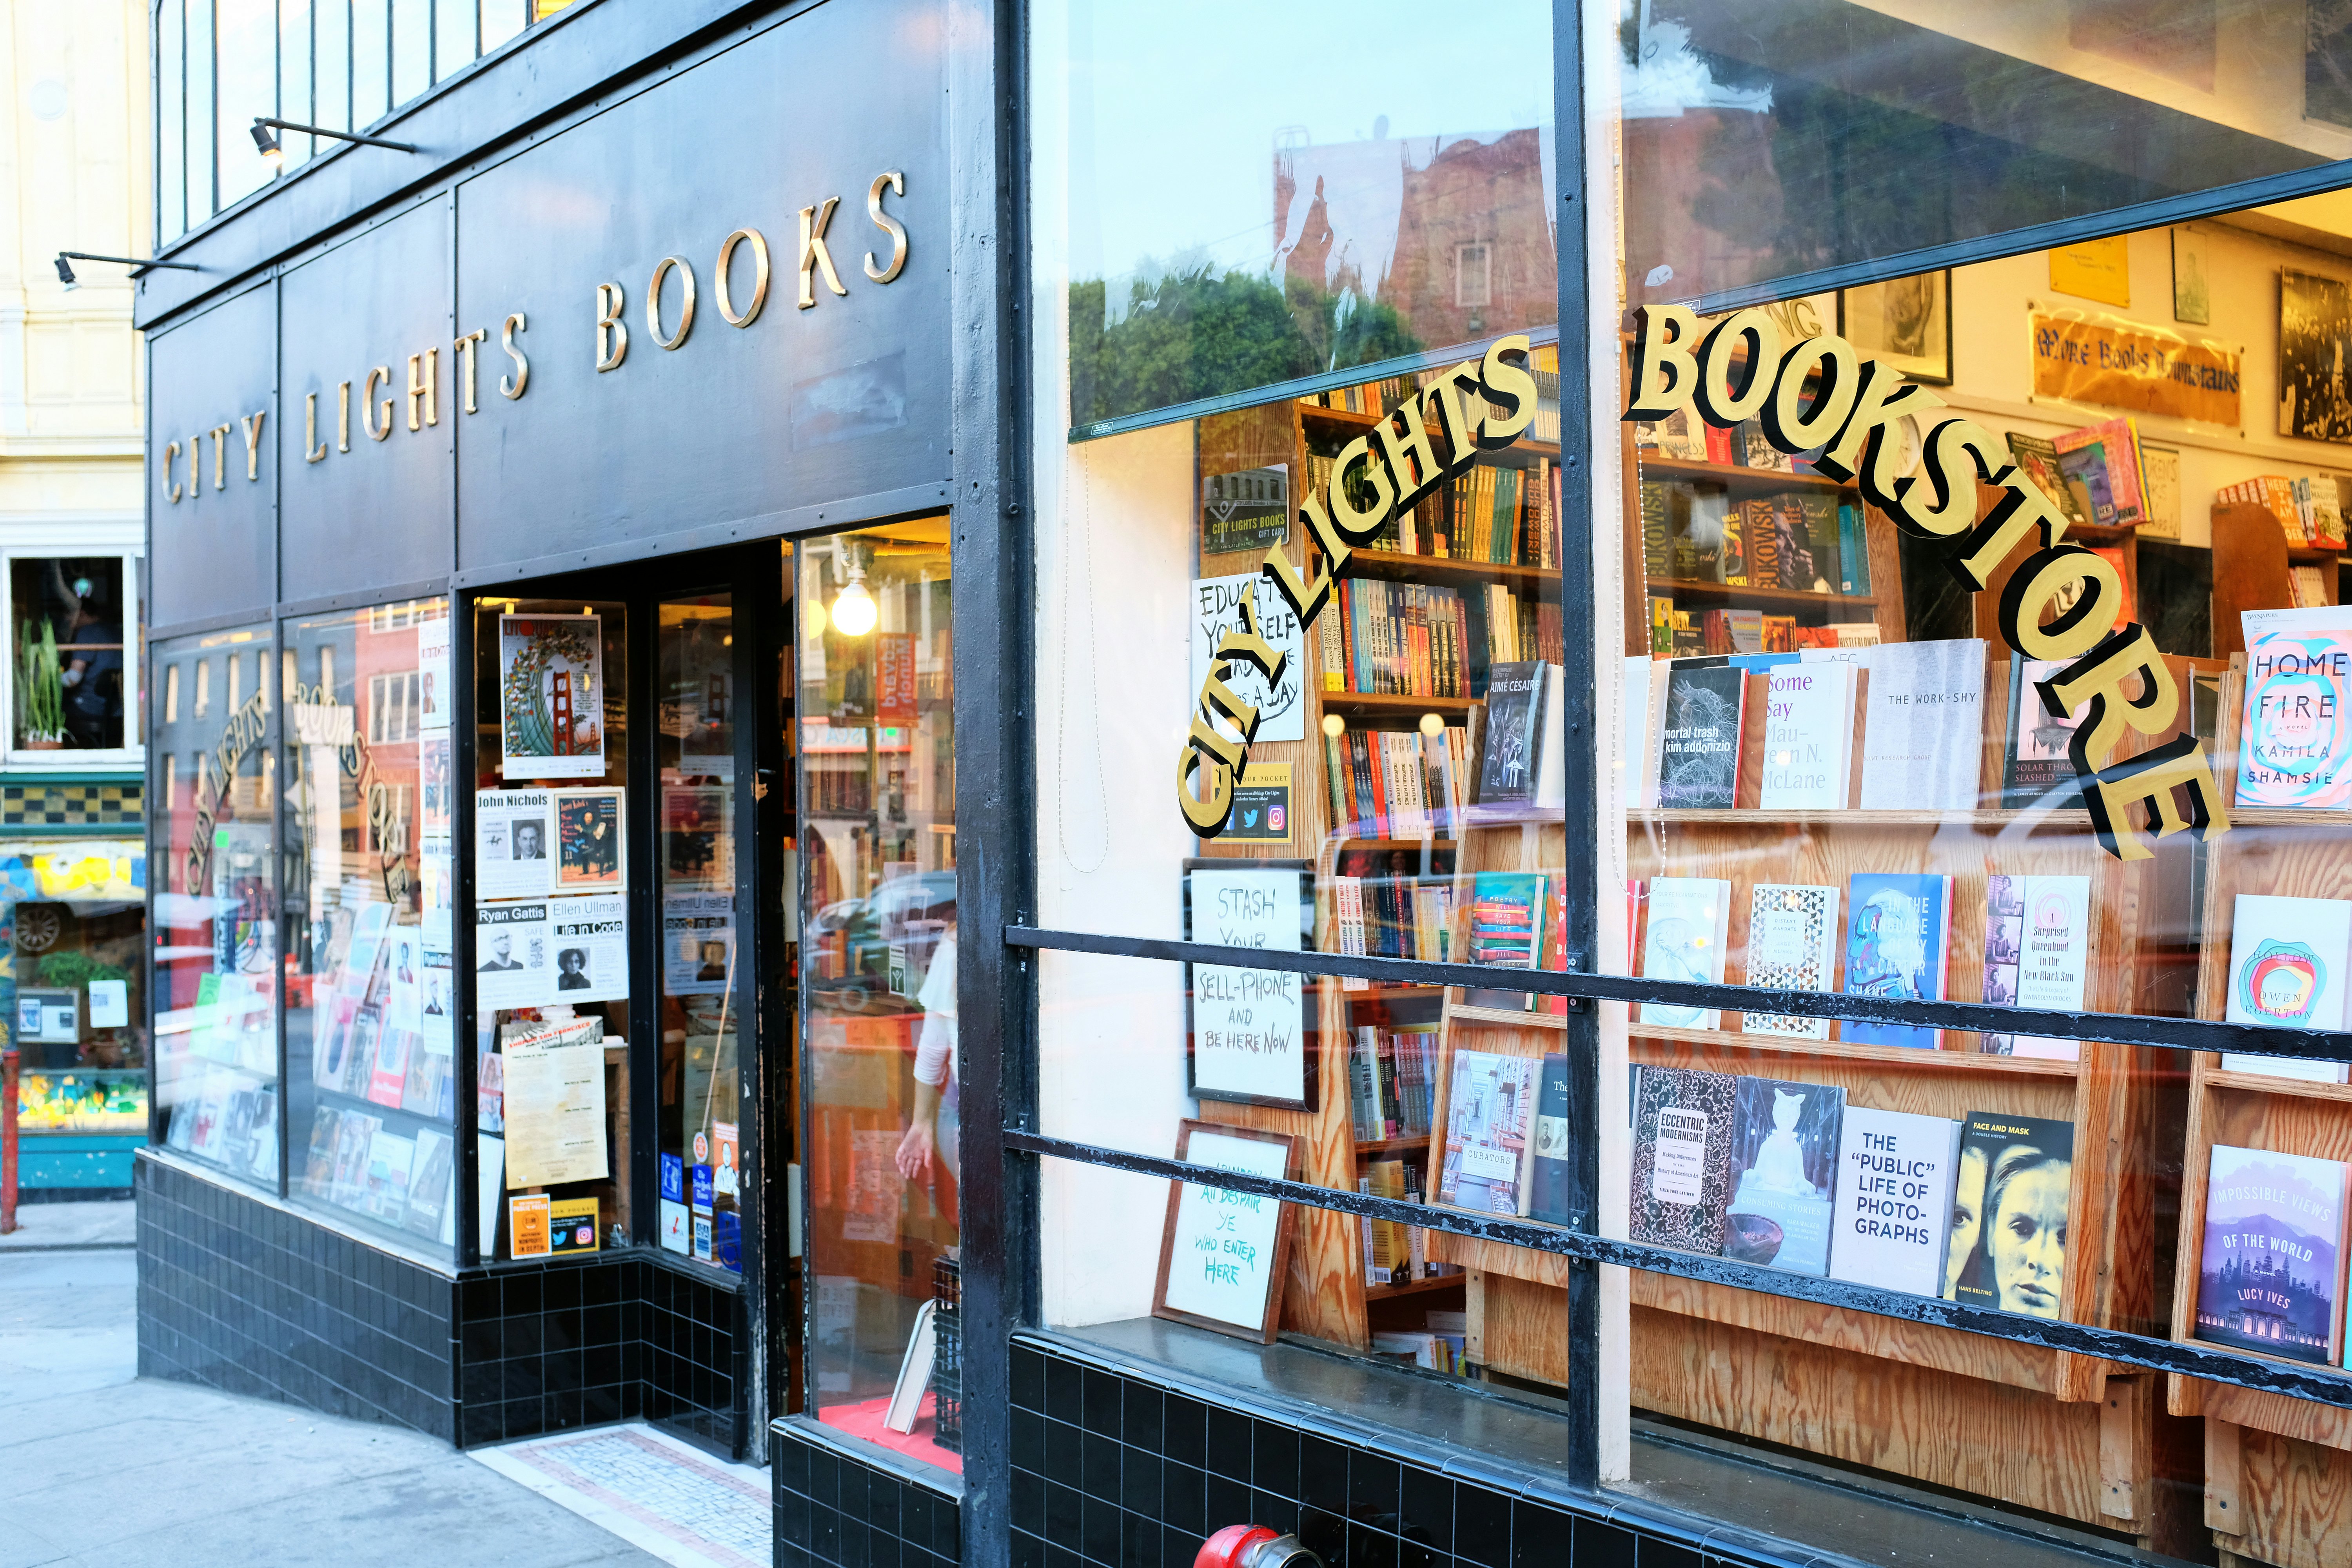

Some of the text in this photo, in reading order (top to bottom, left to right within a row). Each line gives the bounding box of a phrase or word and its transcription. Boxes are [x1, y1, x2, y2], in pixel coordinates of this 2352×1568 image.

[162, 171, 909, 504] CITY LIGHTS BOOKS
[2098, 339, 2149, 376] Books
[2153, 346, 2239, 393] Downstairs
[2266, 478, 2291, 492] HERE
[1212, 514, 1285, 535] CITY LIGHTS BOOKS
[1259, 527, 1284, 538] GIFT CARD
[1752, 502, 1780, 588] BUKOWSKI
[1178, 334, 1538, 838] CITY LIGHTS
[1621, 304, 2231, 862] BOOKSTORE
[1673, 612, 1690, 631] BEAT
[2255, 653, 2348, 678] HOME
[1490, 678, 1540, 693] AIMÉ CÉSAIRE
[1768, 674, 1812, 692] Some
[1267, 681, 1298, 708] DAY
[1888, 692, 1976, 705] THE WORK-SHY
[1767, 699, 1793, 722] Say
[2259, 695, 2335, 719] FIRE
[1664, 726, 1719, 739] mortal trash
[1666, 739, 1731, 754] kim addonizio
[1806, 744, 1822, 763] N.
[2254, 745, 2330, 759] KAMILA
[2016, 762, 2076, 772] SOLAR THRO
[1762, 770, 1826, 789] McLane
[2015, 773, 2055, 782] SLASHED
[2247, 771, 2333, 785] SHAMSIE
[478, 794, 548, 808] John Nichols
[554, 901, 622, 916] Ellen Ullman
[1218, 887, 1276, 921] STASH
[1888, 897, 1929, 914] IN THE
[479, 907, 545, 924] Ryan Gattis
[2049, 913, 2054, 923] A
[592, 921, 622, 934] Code
[1863, 916, 1928, 935] LANGUAGE
[2033, 926, 2069, 939] Surprised
[1888, 938, 1927, 955] OF MY
[2031, 940, 2069, 953] Queenhood
[1878, 957, 1926, 976] CAPTOR
[2040, 955, 2059, 967] in the
[2253, 951, 2315, 964] HOLLOW
[2024, 969, 2074, 982] New Black Sun
[1199, 970, 1294, 1006] SELL-PHONE
[2049, 986, 2063, 995] Legacy
[2259, 990, 2302, 1003] OWEN
[1228, 1007, 1253, 1027] AND
[2245, 1005, 2313, 1020] EGERTON
[1205, 1030, 1221, 1048] BE
[1226, 1031, 1260, 1054] HERE
[1661, 1113, 1705, 1132] ECCENTRIC
[1973, 1122, 2030, 1136] FACE AND MASK
[1660, 1127, 1703, 1143] MODERNISMS
[1863, 1132, 1897, 1152] THE
[1468, 1150, 1511, 1165] CURATORS
[1662, 1151, 1697, 1162] Making Differences
[1851, 1152, 1935, 1178] “PUBLIC”
[1657, 1167, 1670, 1175] History
[1674, 1169, 1693, 1178] American
[1858, 1175, 1929, 1200] LIFE OF
[1219, 1189, 1261, 1214] DESPAIR
[1741, 1196, 1822, 1216] CONSUMING STORIES
[1857, 1196, 1927, 1221] PHOTO-
[2213, 1186, 2332, 1222] IMPOSSIBLE VIEWS
[1215, 1210, 1236, 1232] YE
[1800, 1220, 1820, 1230] WALKER
[1855, 1218, 1929, 1245] GRAPHS
[1195, 1234, 1256, 1272] WHO ENTER
[2222, 1233, 2313, 1263] OF THE WORLD
[1205, 1256, 1240, 1287] HERE
[1972, 1288, 1993, 1297] BELTING
[2237, 1288, 2291, 1310] LUCY IVES
